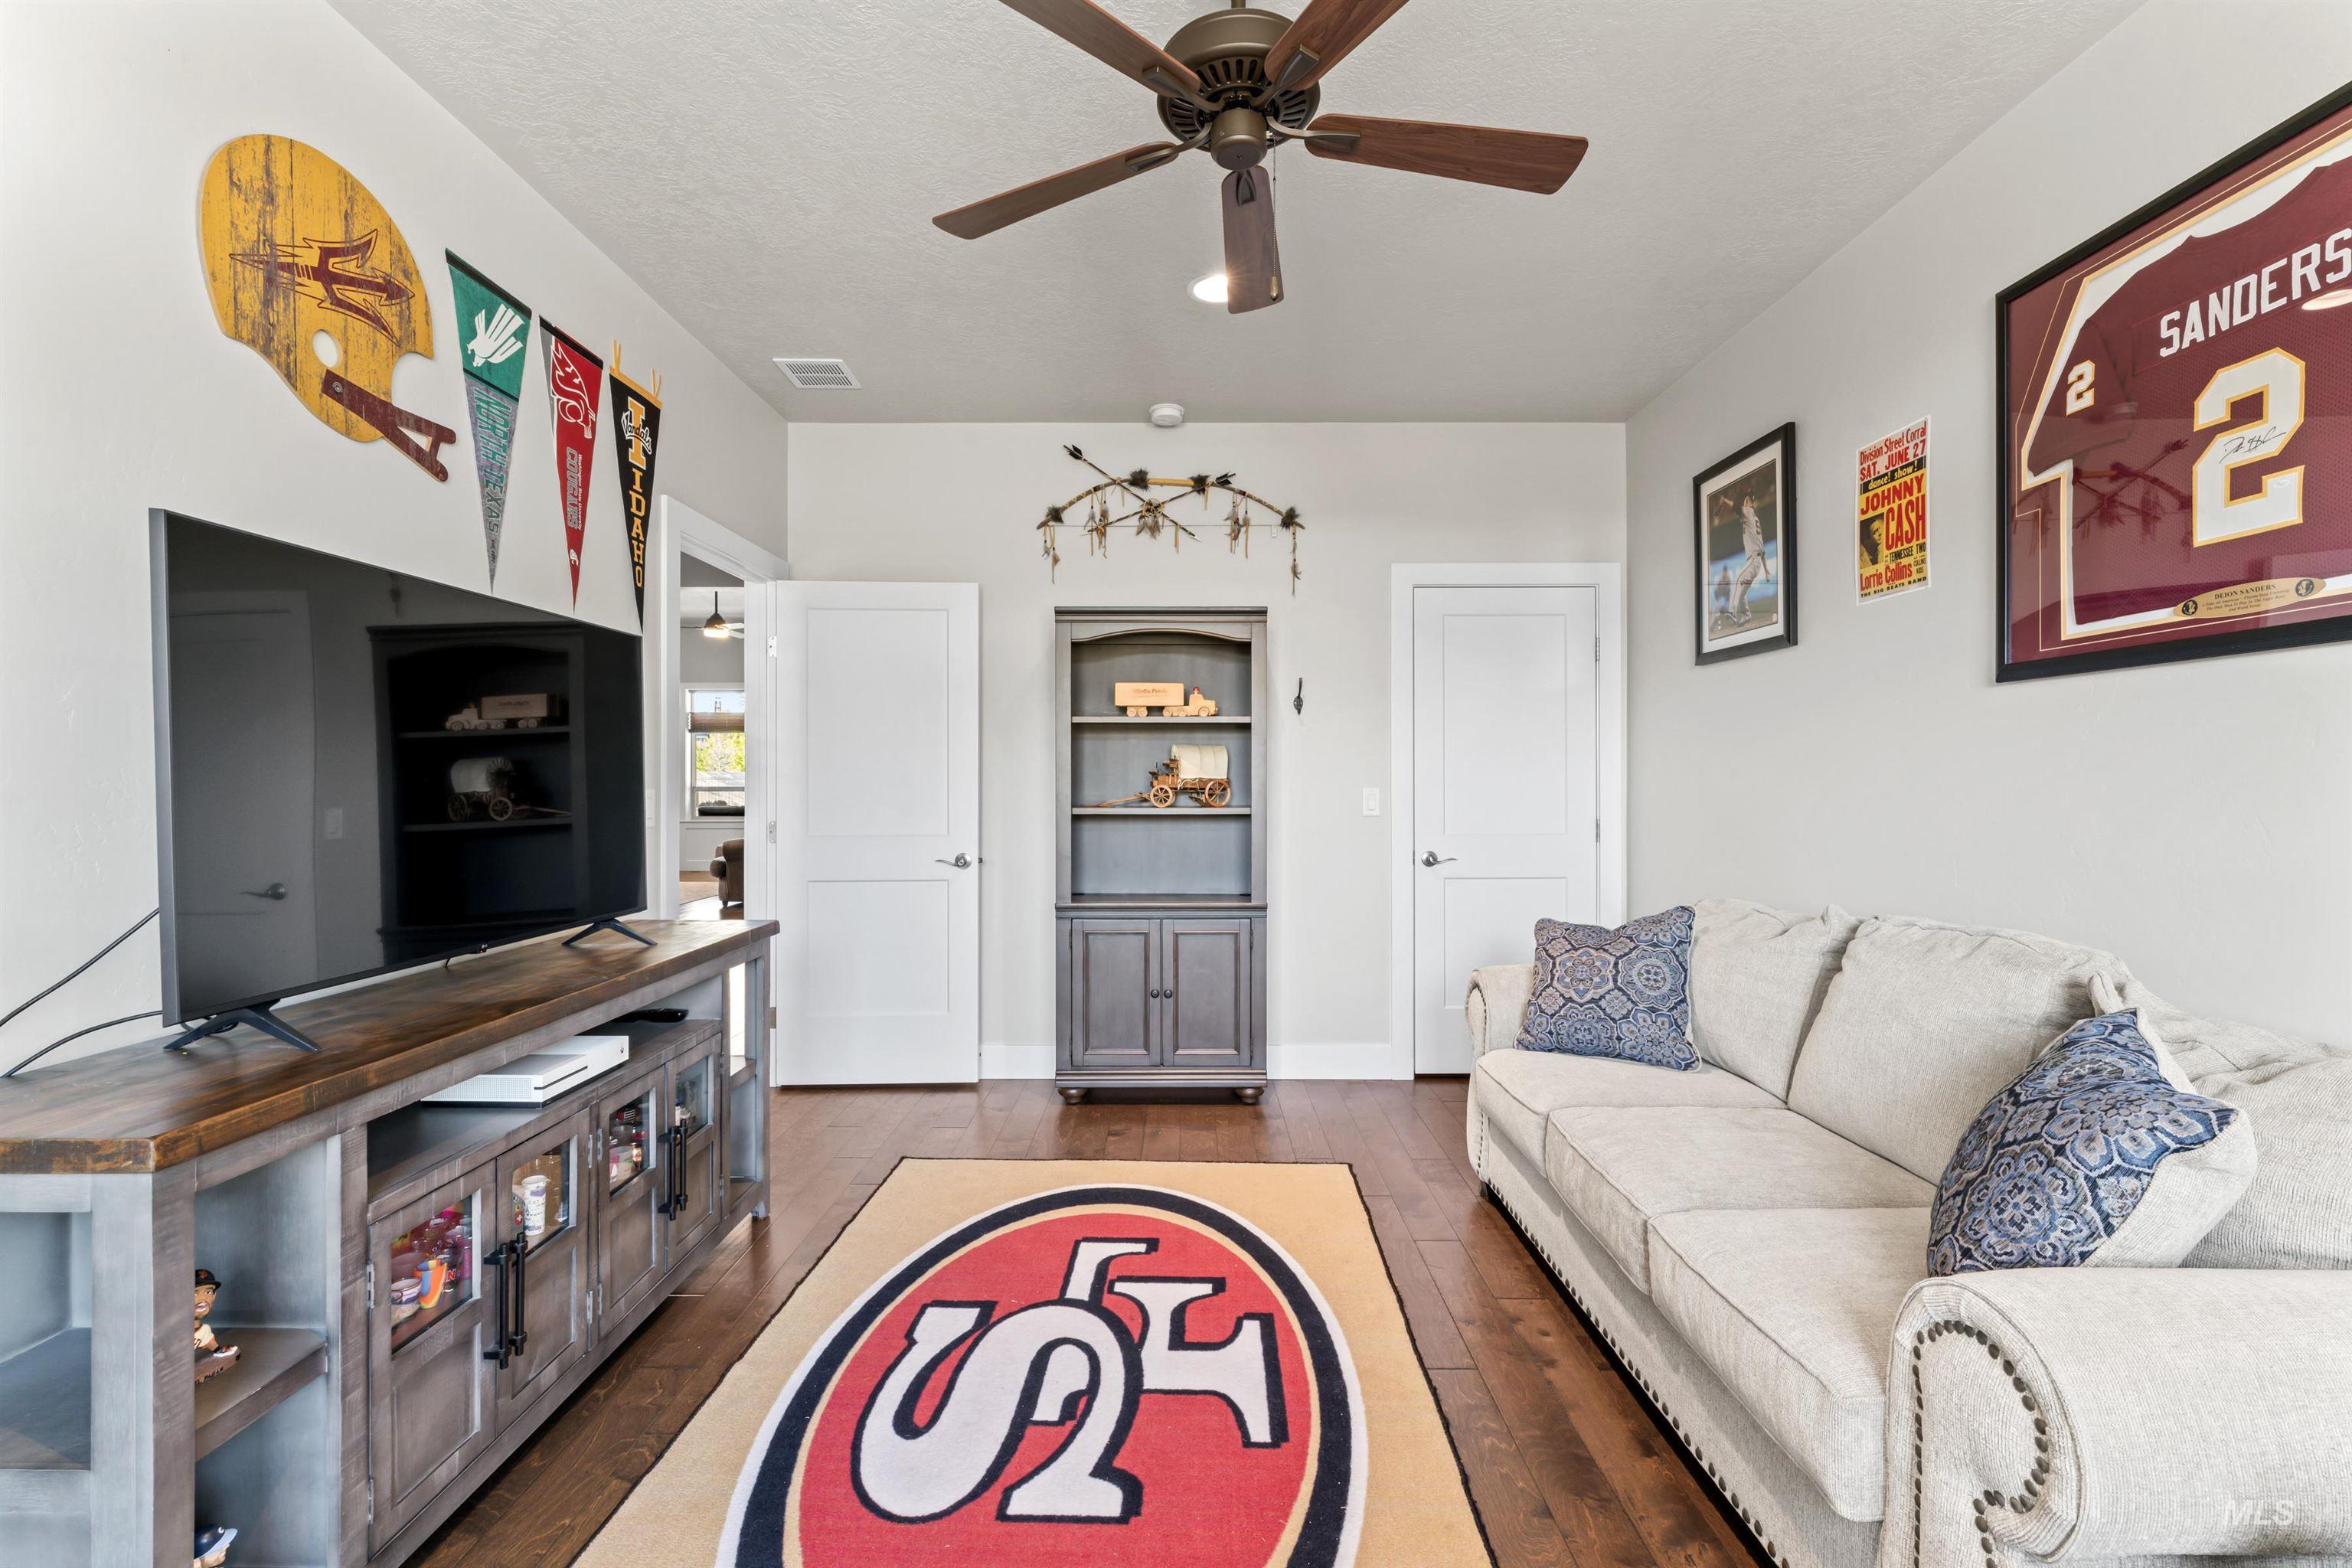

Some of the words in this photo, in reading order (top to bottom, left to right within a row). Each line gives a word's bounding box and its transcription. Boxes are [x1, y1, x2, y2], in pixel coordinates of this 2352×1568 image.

[2159, 227, 2352, 358] SANDERS
[2066, 360, 2095, 416] 2
[472, 386, 512, 468] NORTH
[621, 410, 652, 455] Vandals
[1860, 445, 1883, 466] Division
[1884, 432, 1905, 455] Street
[1906, 420, 1926, 443] Corral
[2193, 347, 2305, 547] 2
[567, 447, 578, 529] COUGARS
[1860, 461, 1880, 482] SAT.
[1885, 446, 1910, 471] JUNE
[1868, 472, 1891, 490] dance!
[1893, 459, 1918, 479] show!
[484, 469, 506, 534] TEXAS
[1860, 472, 1925, 515] JOHNNY
[629, 468, 646, 587] IDAHO
[1884, 494, 1926, 550] CASH
[1860, 569, 1883, 592] Lorrie
[1885, 561, 1913, 583] Collins
[1890, 545, 1913, 563] TENNESSEE
[1916, 541, 1926, 554] TWO
[2214, 590, 2238, 599] DEION
[2239, 584, 2276, 594] SANDERS
[851, 1237, 1289, 1524] SF
